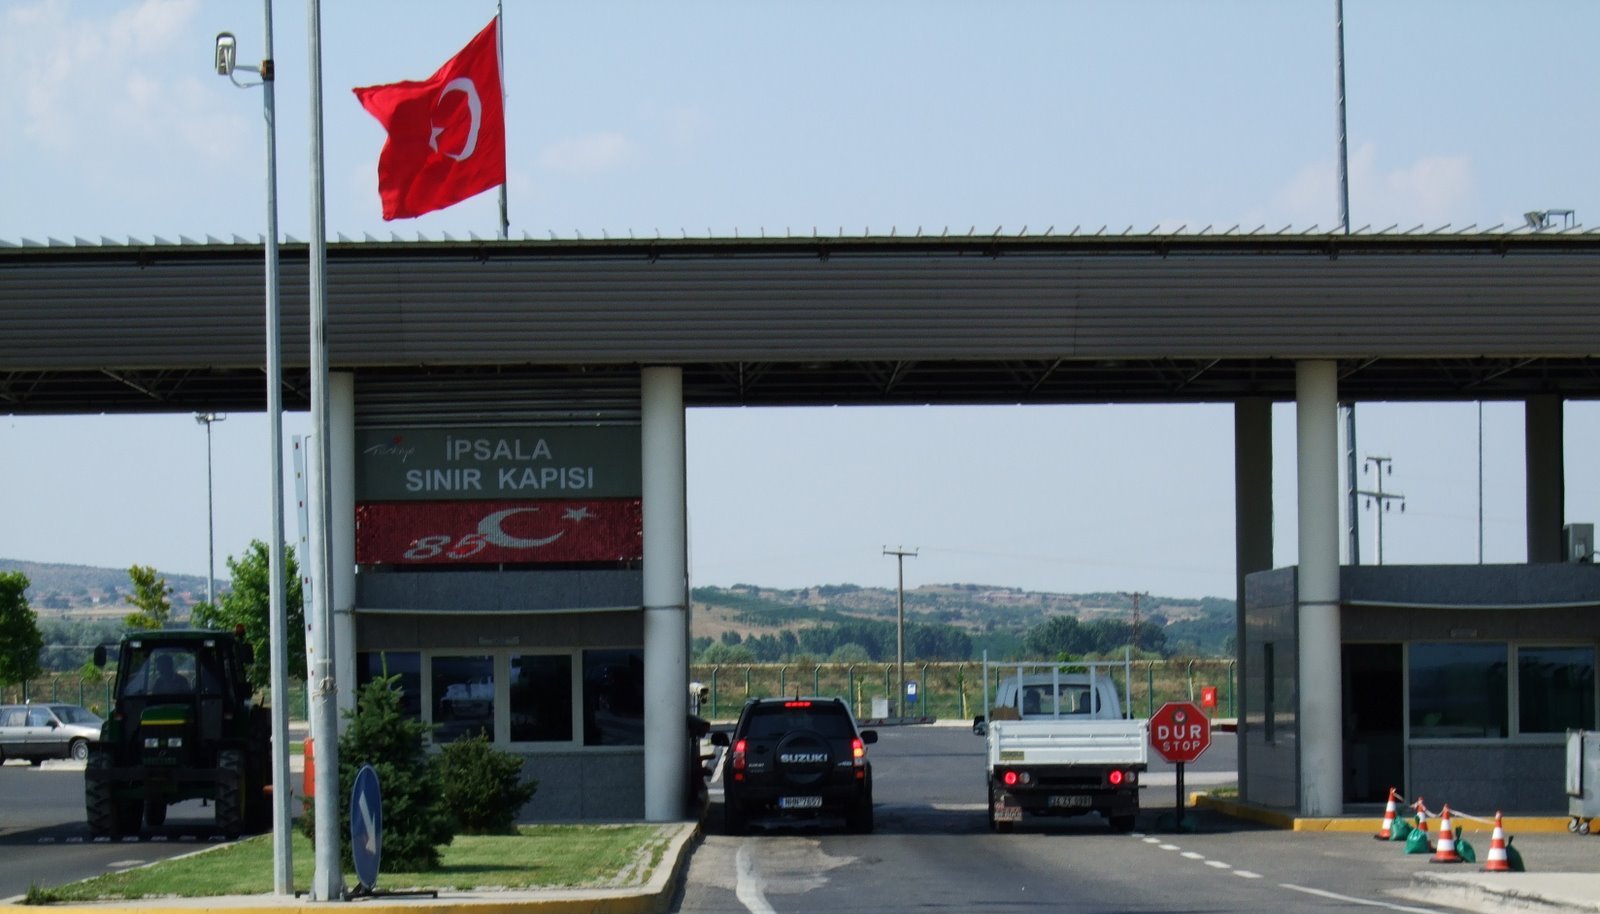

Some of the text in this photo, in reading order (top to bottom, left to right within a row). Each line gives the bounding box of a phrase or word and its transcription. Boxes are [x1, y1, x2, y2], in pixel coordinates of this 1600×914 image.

[446, 435, 553, 461] İPSALA
[405, 466, 595, 491] SINIR KAPISI
[402, 533, 488, 560] 85
[1157, 724, 1203, 741] DUR
[1162, 740, 1201, 752] STOP
[780, 753, 828, 763] SUZUKI
